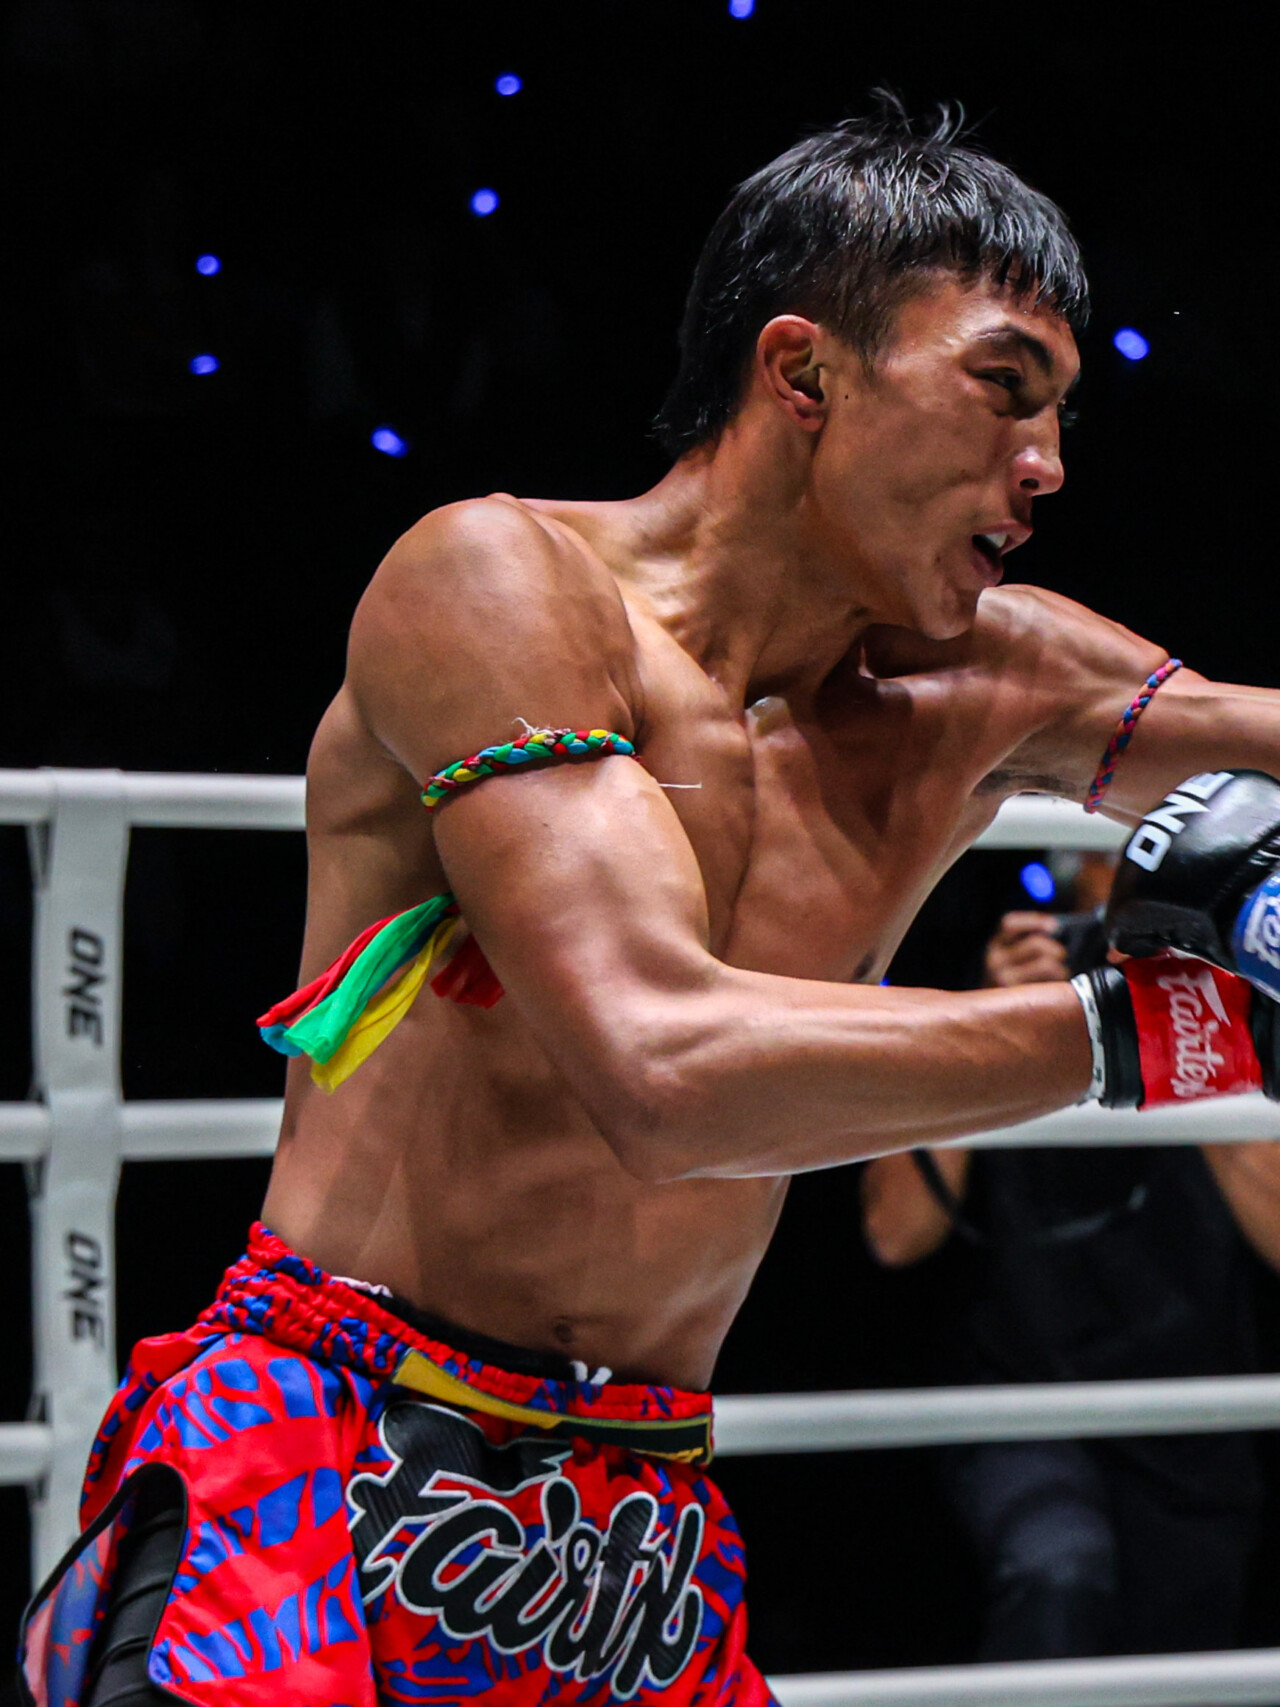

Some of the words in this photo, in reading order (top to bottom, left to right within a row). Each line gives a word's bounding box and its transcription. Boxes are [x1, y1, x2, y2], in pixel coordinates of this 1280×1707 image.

[1126, 771, 1235, 872] ONE
[64, 928, 105, 1047] ONE
[65, 1231, 106, 1348] ONE
[346, 1402, 706, 1699] Fairtx
